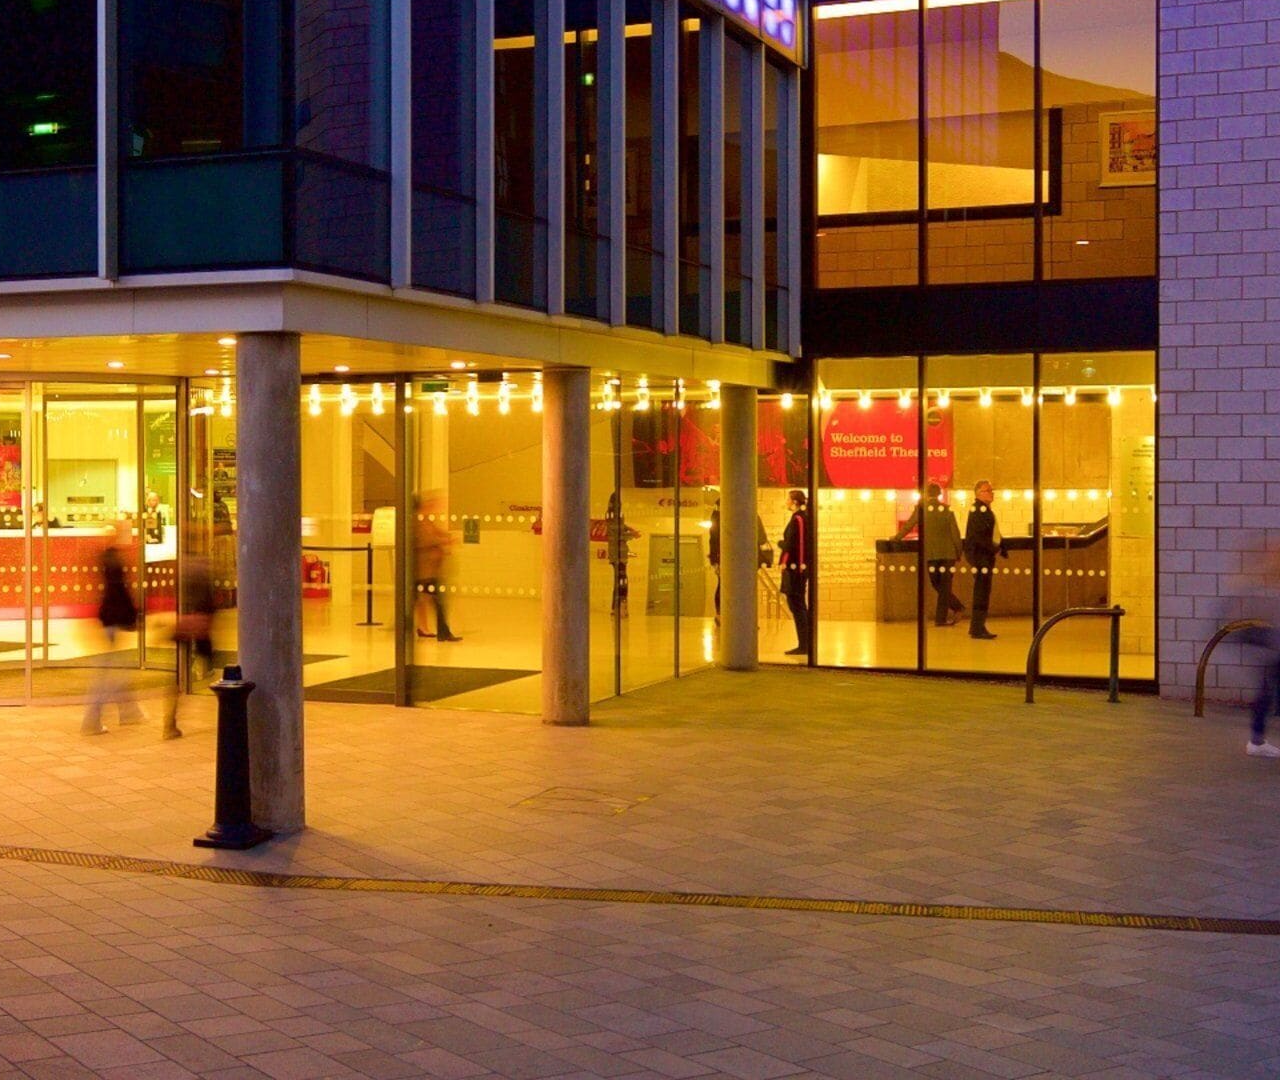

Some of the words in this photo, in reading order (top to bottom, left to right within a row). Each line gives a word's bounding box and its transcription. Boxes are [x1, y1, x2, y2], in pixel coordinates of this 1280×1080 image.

[831, 433, 887, 443] Welcome
[890, 433, 903, 443] to
[830, 447, 887, 457] Sheffield
[890, 447, 948, 457] Theares
